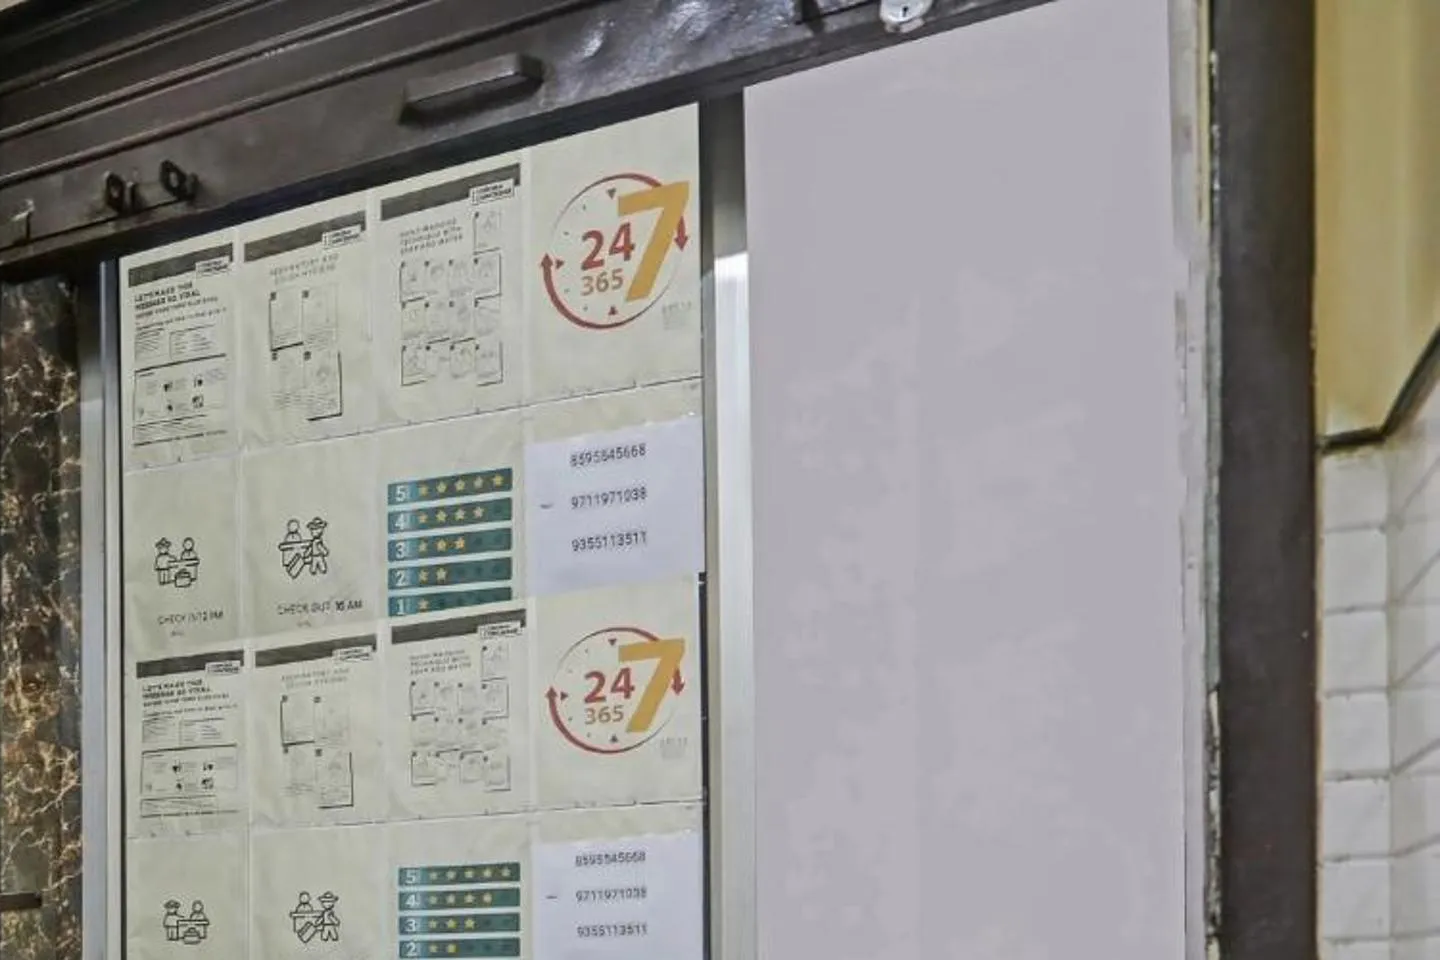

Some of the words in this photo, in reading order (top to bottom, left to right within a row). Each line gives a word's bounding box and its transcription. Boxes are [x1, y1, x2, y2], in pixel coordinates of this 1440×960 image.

[580, 221, 636, 271] 24
[617, 180, 690, 303] 7
[580, 268, 624, 297] 365
[395, 484, 408, 502] 5
[395, 513, 407, 530] 4
[395, 542, 406, 558] 3
[395, 570, 407, 587] 2
[396, 598, 406, 615] 1
[583, 666, 636, 704] 24
[617, 638, 686, 733] 7
[584, 704, 625, 725] 365
[405, 871, 417, 884] 5
[405, 919, 417, 932] 3
[405, 942, 417, 957] 2
